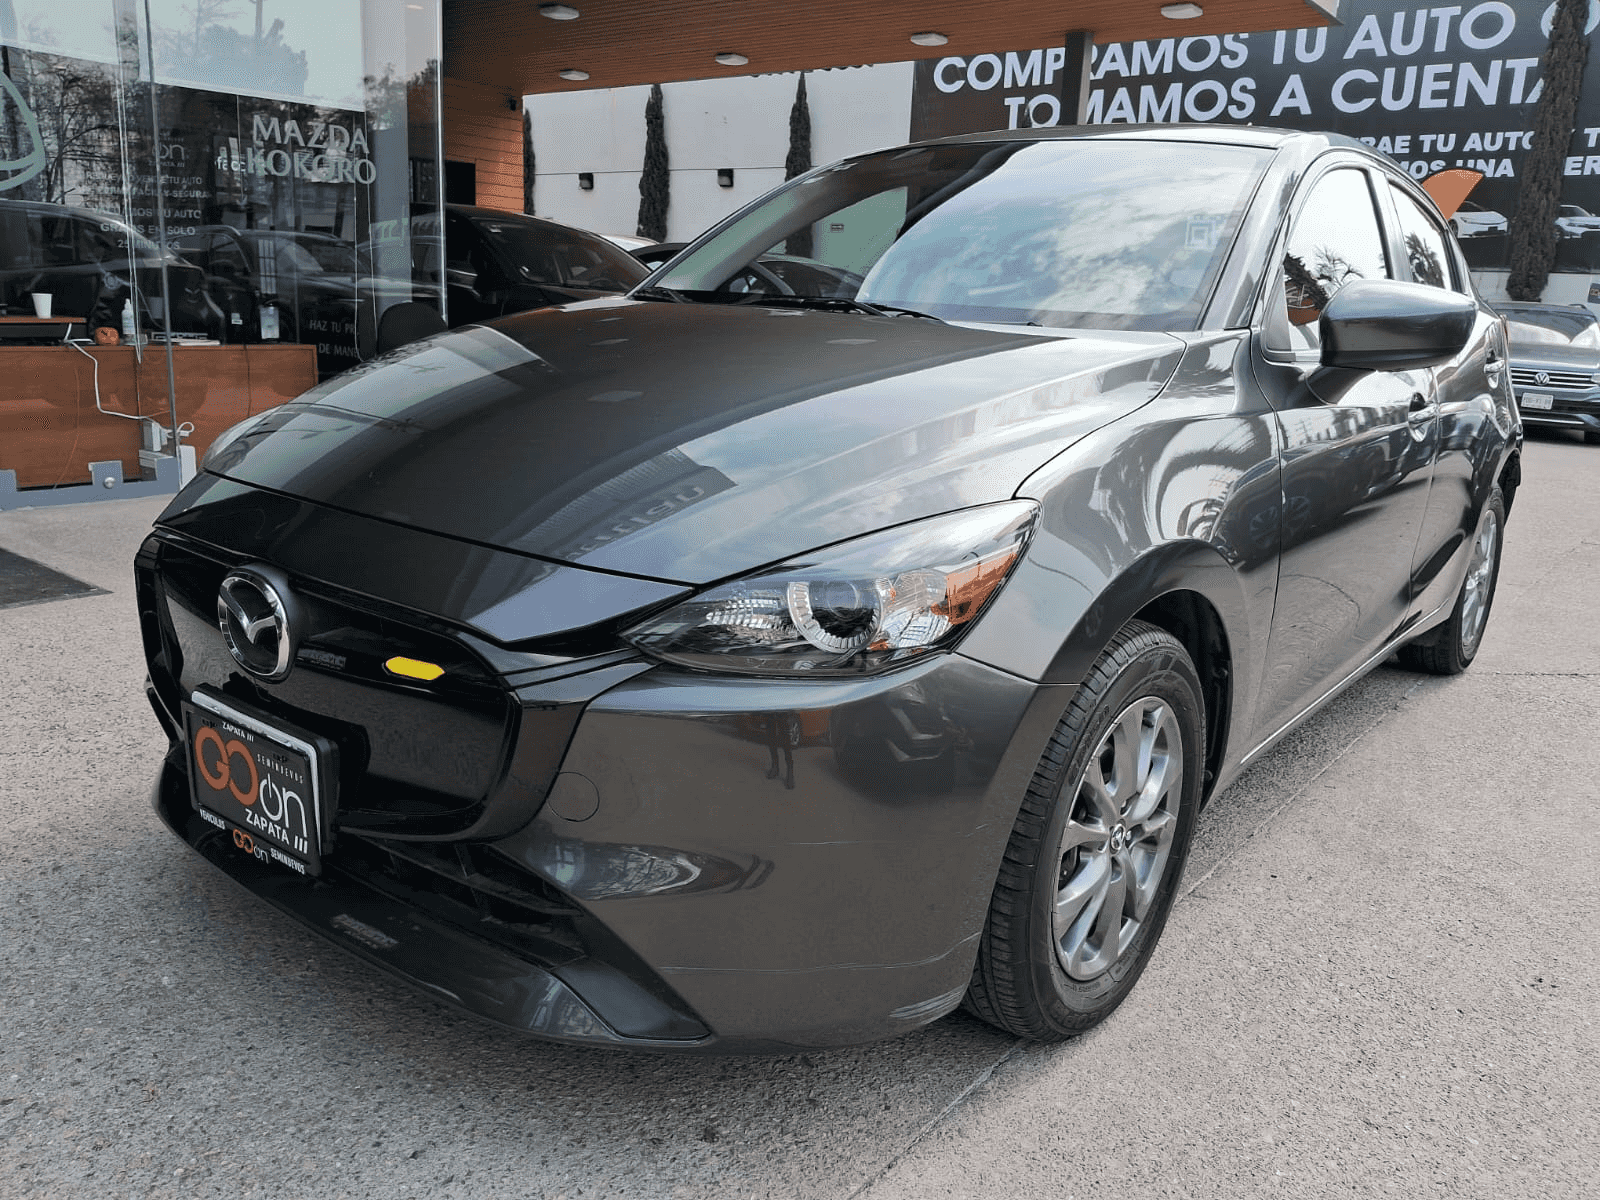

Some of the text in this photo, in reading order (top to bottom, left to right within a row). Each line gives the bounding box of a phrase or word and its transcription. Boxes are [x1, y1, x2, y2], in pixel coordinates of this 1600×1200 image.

[1343, 1, 1516, 60] AUTO
[1269, 74, 1312, 117] A
[252, 114, 370, 154] MAZDA
[1419, 134, 1457, 153] TU
[245, 147, 377, 185] KOKORO
[167, 226, 196, 236] SOLO
[308, 319, 328, 331] HAZ
[331, 321, 342, 333] TU
[222, 720, 246, 739] ZAPATA
[244, 808, 308, 855] ZAPATA III
